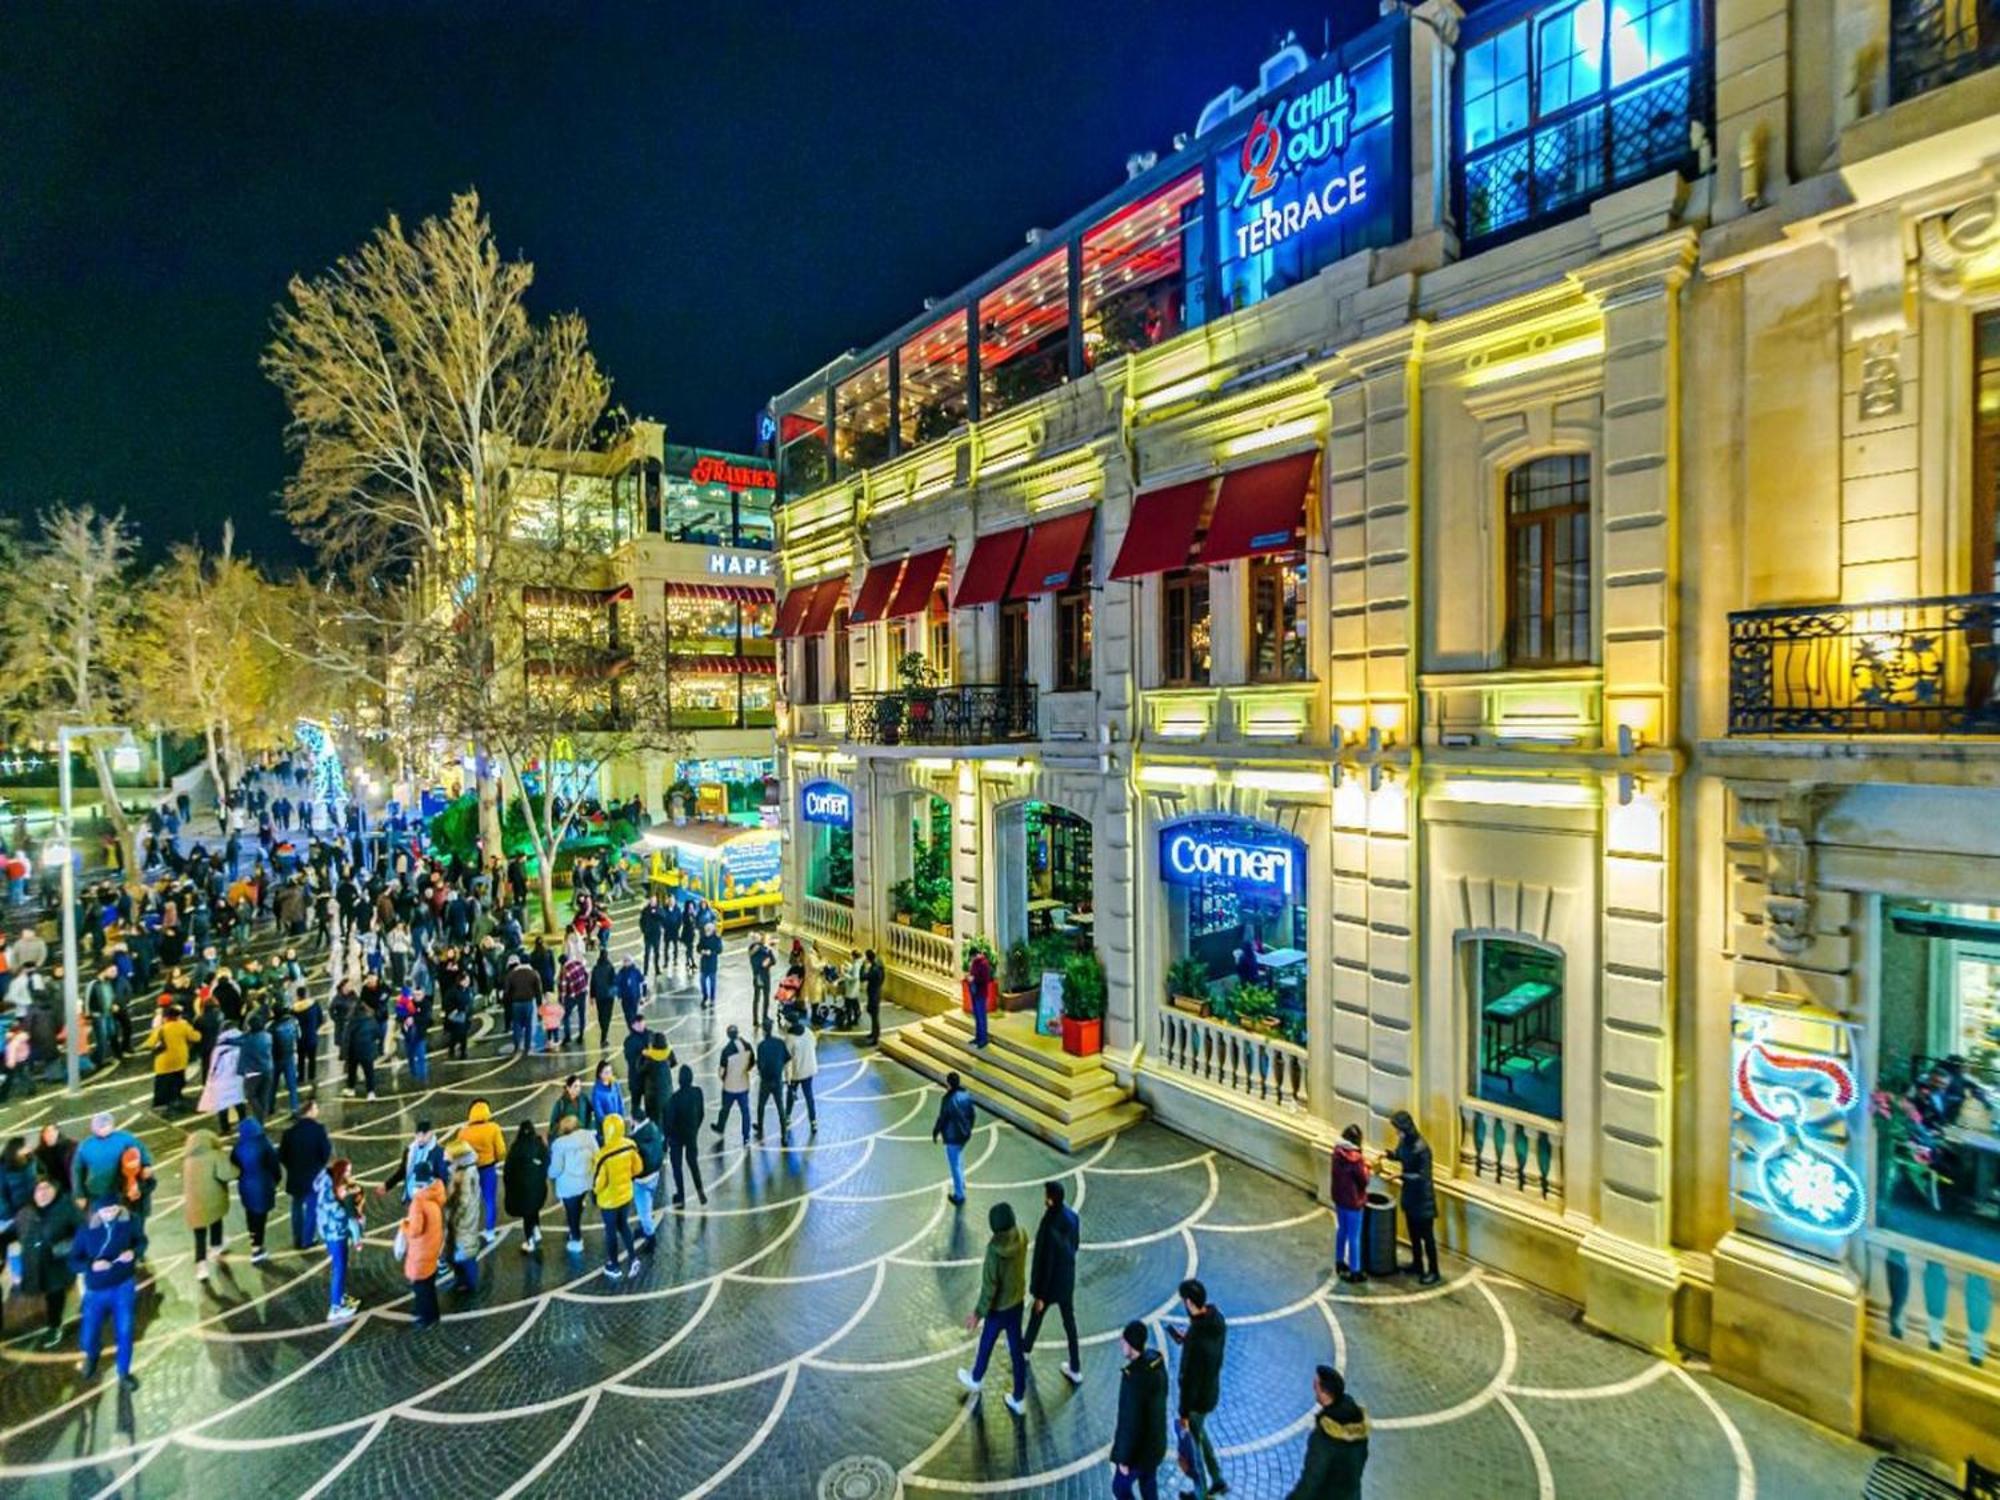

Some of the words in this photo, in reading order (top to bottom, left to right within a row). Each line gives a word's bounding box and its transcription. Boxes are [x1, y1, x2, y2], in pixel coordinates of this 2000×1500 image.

[1286, 71, 1349, 131] CHILL
[1287, 106, 1349, 163] OUT
[1236, 164, 1367, 259] TERRACE
[1171, 835, 1291, 890] Corner
